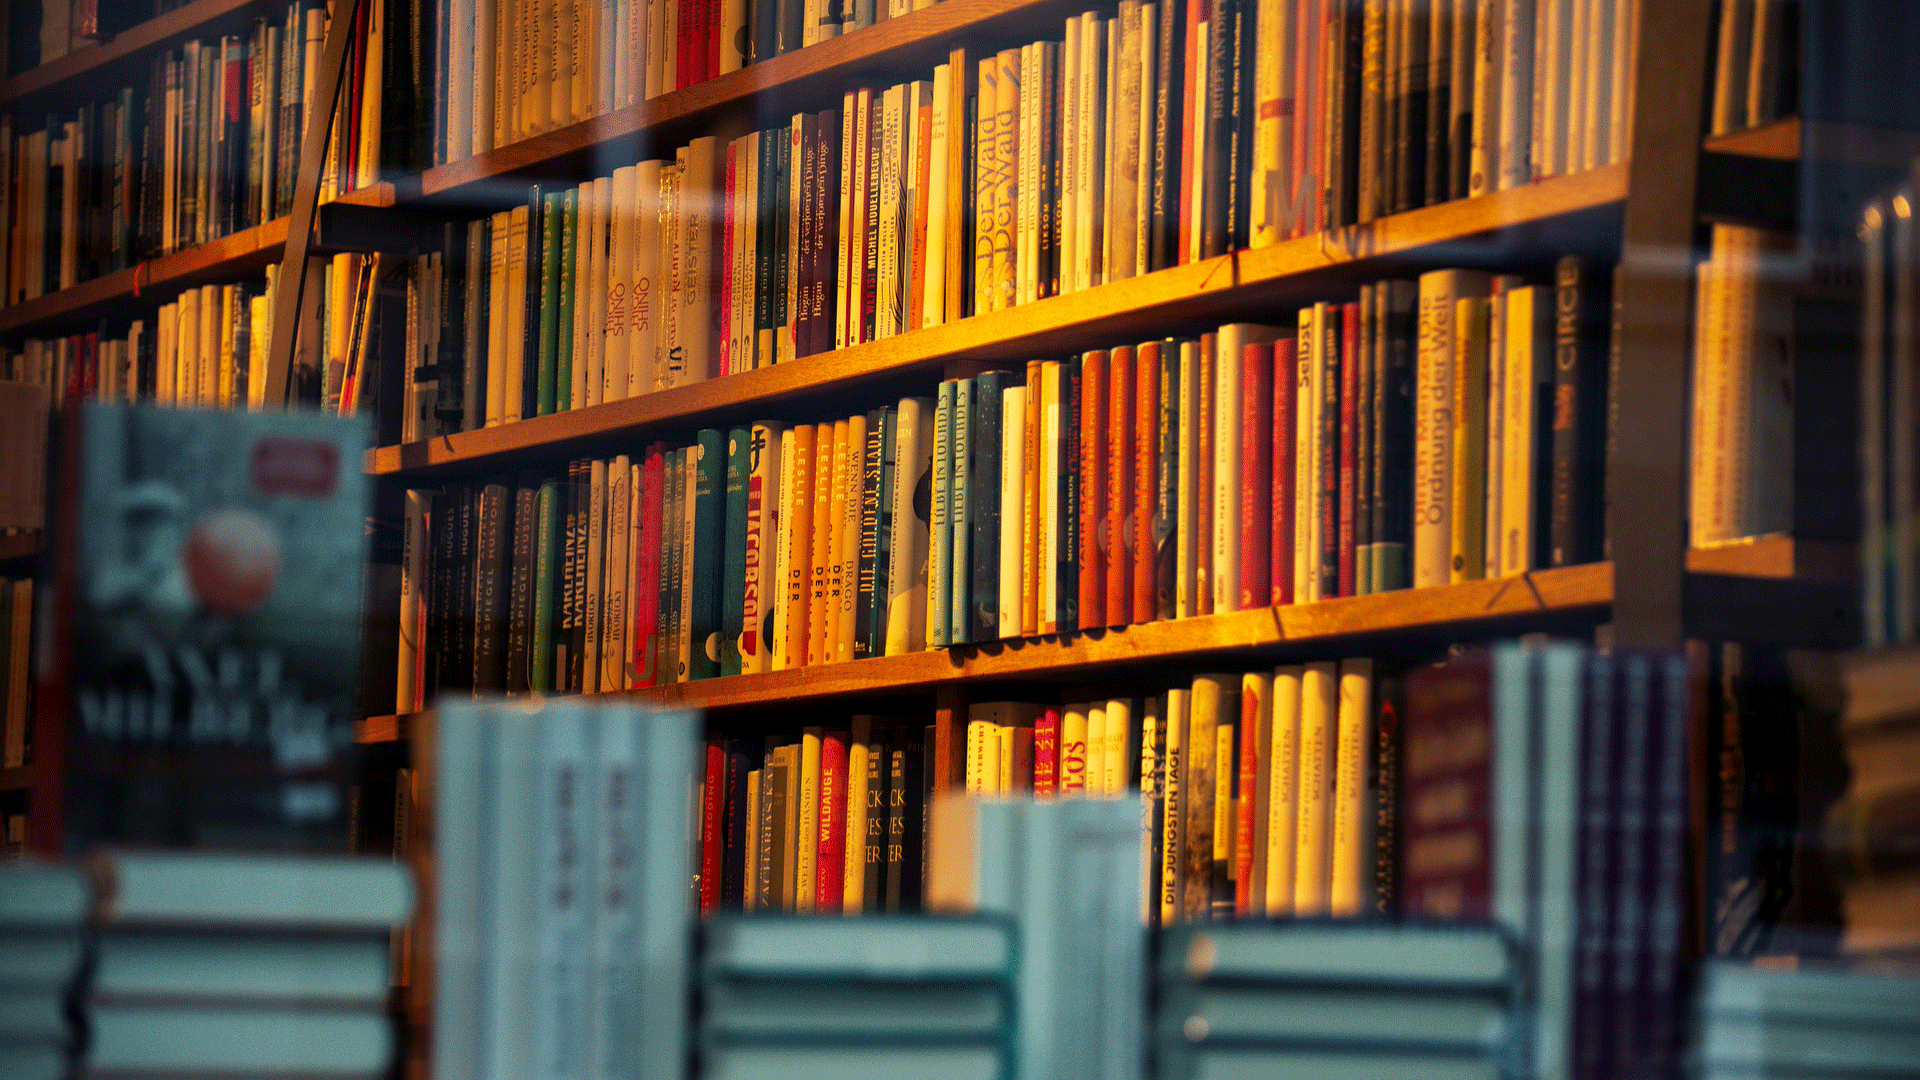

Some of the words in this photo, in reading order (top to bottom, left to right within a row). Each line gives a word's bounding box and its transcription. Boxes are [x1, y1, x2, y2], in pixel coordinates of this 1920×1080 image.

[531, 14, 539, 85] Christoph
[572, 4, 580, 75] Christoph
[1021, 57, 1029, 105] BERLIN
[1032, 53, 1040, 99] BERLIN
[1066, 77, 1075, 124] Matrosen
[1081, 73, 1090, 119] Matrosen
[1020, 107, 1027, 119] IN
[1031, 103, 1038, 116] IN
[1155, 88, 1167, 170] LONDON
[1231, 95, 1239, 116] Aus
[819, 140, 829, 174] Dinge
[842, 110, 851, 171] Grundbuch
[856, 106, 865, 168] Grundbuch
[977, 116, 997, 197] Wald
[995, 108, 1014, 191] Wald
[1065, 127, 1074, 143] der
[1080, 124, 1089, 139] der
[805, 145, 815, 180] Dinge
[855, 171, 863, 192] Das
[1018, 129, 1026, 196] LIEBMANN
[1029, 125, 1037, 192] LIEBMANN
[1064, 146, 1074, 195] Aufstand
[1079, 141, 1089, 192] Aufstand
[804, 181, 812, 236] verlorenen
[818, 175, 826, 231] verlorenen
[841, 174, 849, 195] Das
[868, 147, 879, 226] HOUELLEBECQ?
[1154, 175, 1163, 216] JACK
[976, 201, 995, 260] Der
[994, 197, 1012, 253] Der
[1017, 198, 1025, 233] IRINA
[1041, 203, 1050, 249] LIKSOM
[1054, 199, 1063, 245] LIKSOM
[672, 243, 680, 292] RELATIV
[686, 213, 698, 305] GEISTER
[838, 235, 847, 289] Hochhuth
[852, 232, 861, 286] Hochhuth
[867, 228, 877, 269] MICHEL
[614, 283, 625, 336] SHINO
[637, 277, 650, 330] SHINO
[799, 286, 811, 321] Hogan
[813, 281, 825, 316] Hogan
[866, 292, 875, 314] WER
[1419, 296, 1431, 339] Die
[1430, 293, 1448, 350] Welt
[1556, 264, 1580, 371] CIRCE
[1298, 321, 1311, 388] Selbst
[1430, 358, 1447, 400] der
[1070, 375, 1081, 406] Kopf
[1200, 353, 1209, 447] SEPTEMBER
[1416, 348, 1430, 442] Menzel
[937, 393, 948, 463] LOURDES
[955, 390, 966, 460] LOURDES
[664, 462, 672, 495] BLAU
[675, 459, 683, 491] BLAU
[795, 447, 806, 506] LESLIE
[818, 444, 829, 504] LESLIE
[835, 442, 846, 502] LESLIE
[848, 451, 859, 493] WENN
[865, 429, 880, 478] STADT
[936, 464, 946, 481] IN
[955, 464, 965, 479] IN
[1427, 407, 1452, 525] Ordnung
[674, 495, 682, 531] NOCH
[776, 533, 784, 568] Vierzehn
[780, 442, 788, 490] Greenwich
[847, 498, 856, 523] DIE
[934, 485, 946, 526] LIEBE
[954, 482, 965, 524] LIEBE
[1415, 449, 1428, 527] Ulrich
[446, 507, 455, 558] HUGUES
[488, 496, 497, 559] HUSTON
[522, 491, 531, 554] HUSTON
[662, 498, 671, 534] NOCH
[861, 487, 877, 558] GOLDENE
[1024, 489, 1032, 544] MANTEL
[660, 538, 669, 591] HIMMEL
[672, 536, 680, 589] HIMMEL
[741, 510, 761, 633] JACOBSON
[890, 511, 898, 582] ARCHITEKTUR
[1023, 546, 1031, 597] HILARY
[484, 568, 494, 631] SPIEGEL
[517, 564, 528, 627] SPIEGEL
[562, 527, 576, 629] KARLHEINZ
[574, 524, 586, 627] KARLHEINZ
[791, 569, 800, 602] DER
[814, 566, 824, 599] DER
[831, 565, 841, 598] DER
[843, 560, 854, 612] DRAGO
[859, 566, 874, 592] DIE
[483, 637, 491, 655] IM
[516, 634, 524, 652] IM
[658, 613, 666, 652] ILLIES
[670, 611, 678, 650] ILLIES
[1035, 725, 1044, 750] 21
[1044, 725, 1054, 750] 21
[1349, 723, 1360, 798] SCHATTEN
[1066, 740, 1085, 788] LOS
[1169, 746, 1179, 786] TAGE
[1282, 729, 1292, 803] SCHATTEN
[1313, 726, 1323, 801] SCHATTEN
[1378, 731, 1388, 825] MUNRO
[706, 774, 715, 842] WEDDING
[802, 777, 811, 824] HÄNDEN
[821, 767, 833, 841] WILDAUGE
[762, 802, 773, 906] ZACHARIAS
[801, 856, 809, 887] WELT
[802, 844, 809, 852] in
[1165, 878, 1175, 904] DIE
[1376, 837, 1387, 911] ALICE
